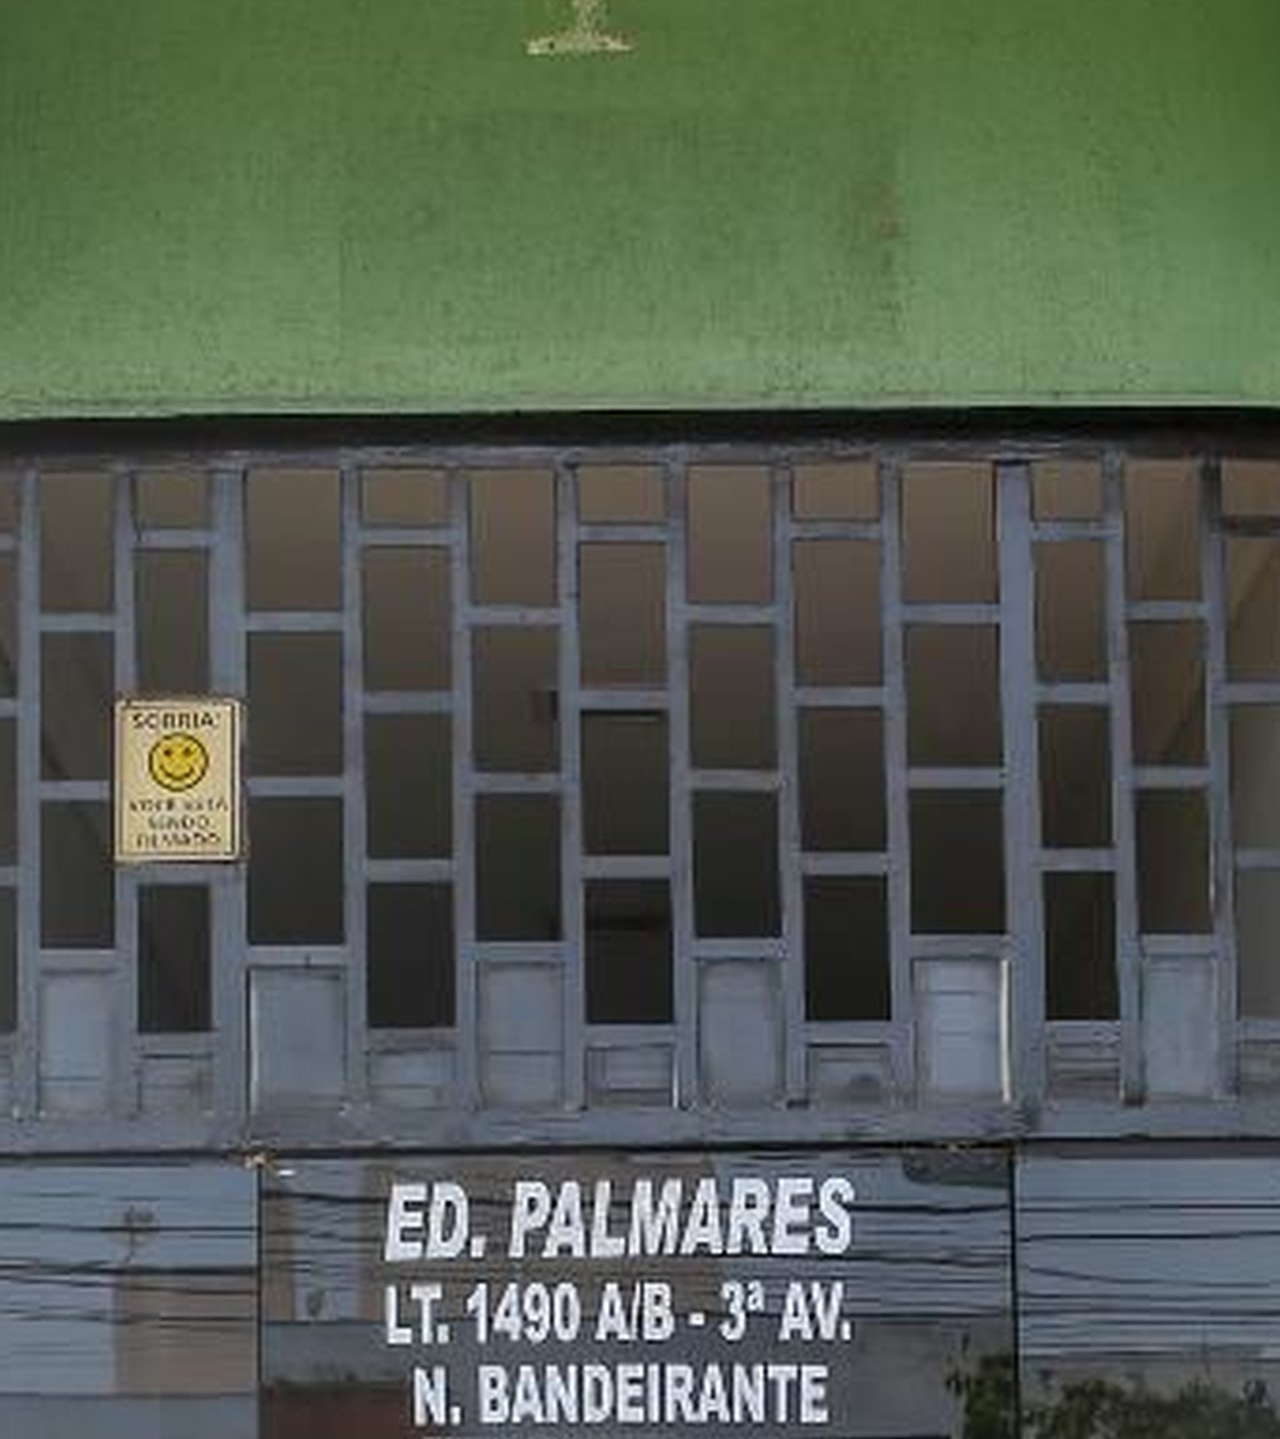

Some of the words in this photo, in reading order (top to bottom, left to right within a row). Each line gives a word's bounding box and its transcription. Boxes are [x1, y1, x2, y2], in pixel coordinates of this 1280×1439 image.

[384, 1181, 488, 1262] ED.
[507, 1176, 857, 1260] PALMARES
[383, 1283, 451, 1346] LT.
[466, 1281, 583, 1344] 1490
[594, 1281, 675, 1343] A/B
[777, 1280, 854, 1342] AV.
[413, 1366, 462, 1427] N.
[477, 1363, 831, 1425] BANDEIRANTE
